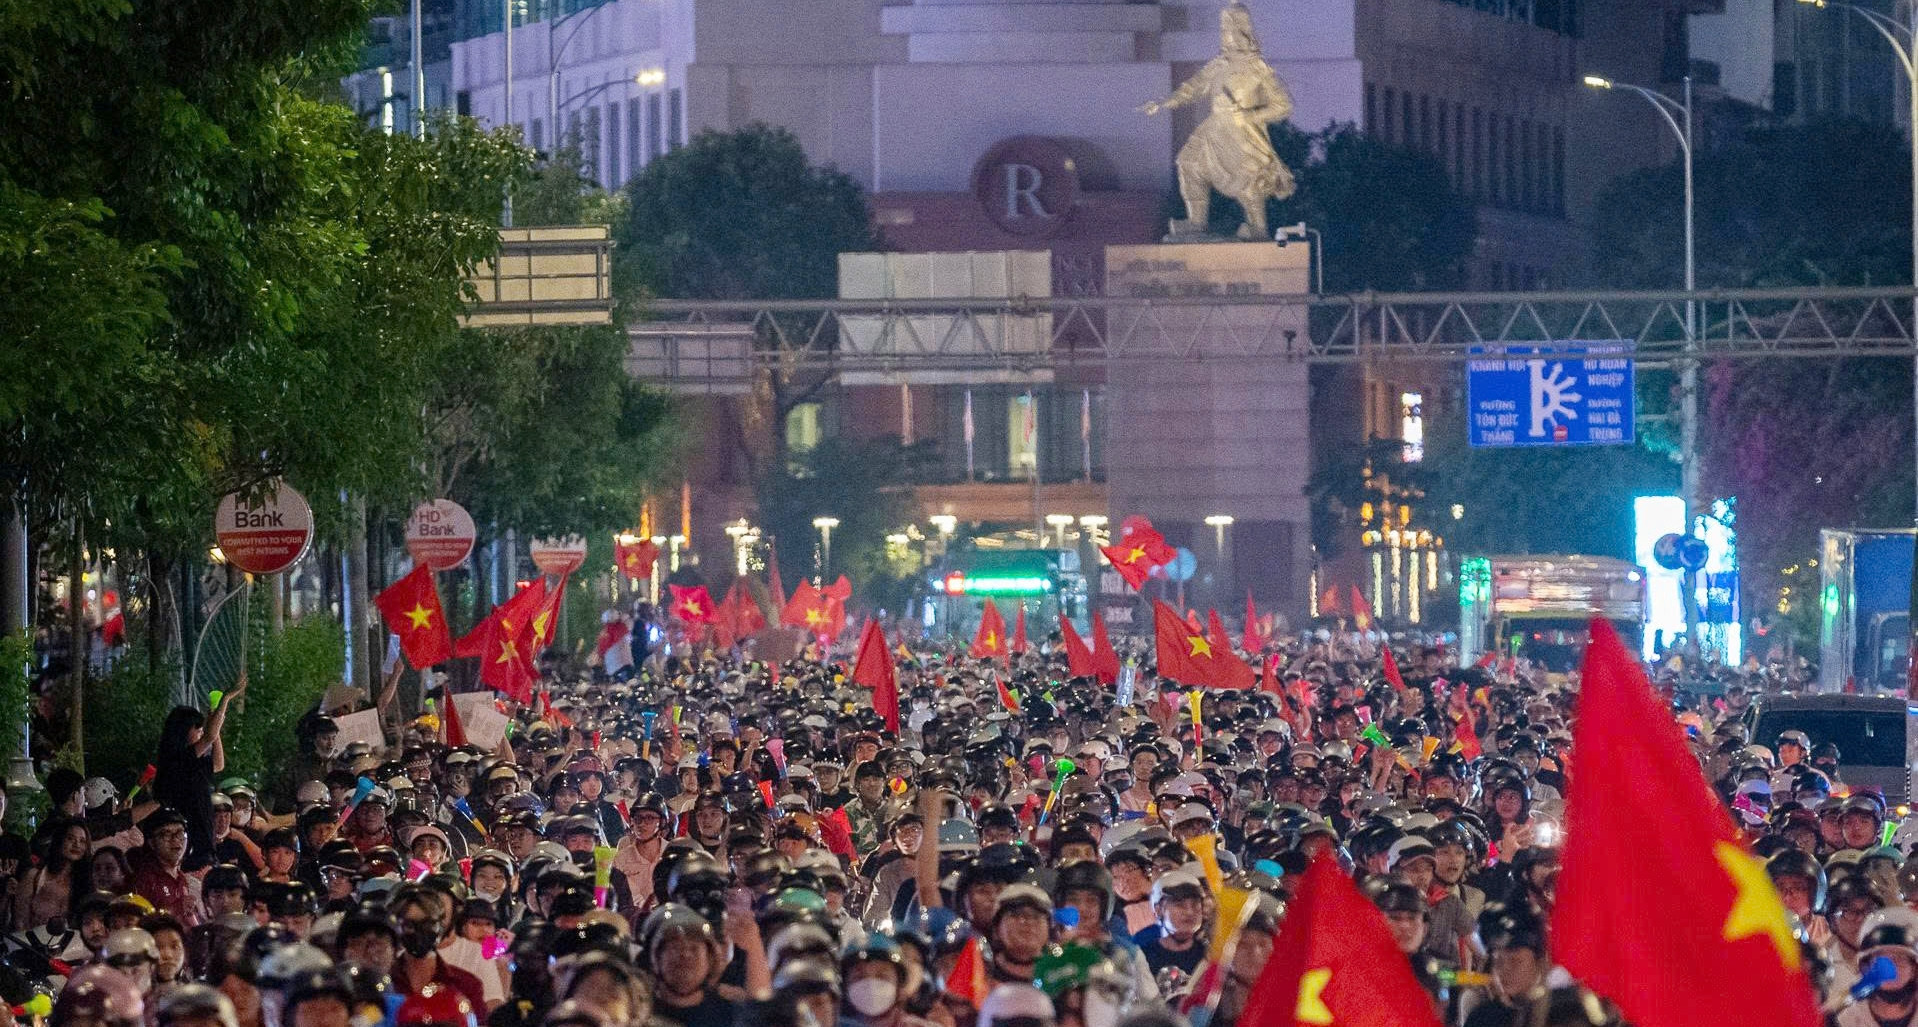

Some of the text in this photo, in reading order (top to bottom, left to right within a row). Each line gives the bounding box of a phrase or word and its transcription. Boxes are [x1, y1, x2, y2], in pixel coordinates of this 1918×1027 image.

[1006, 164, 1049, 217] R
[235, 511, 283, 528] Bank
[419, 510, 440, 523] HD
[419, 523, 456, 536] Bank
